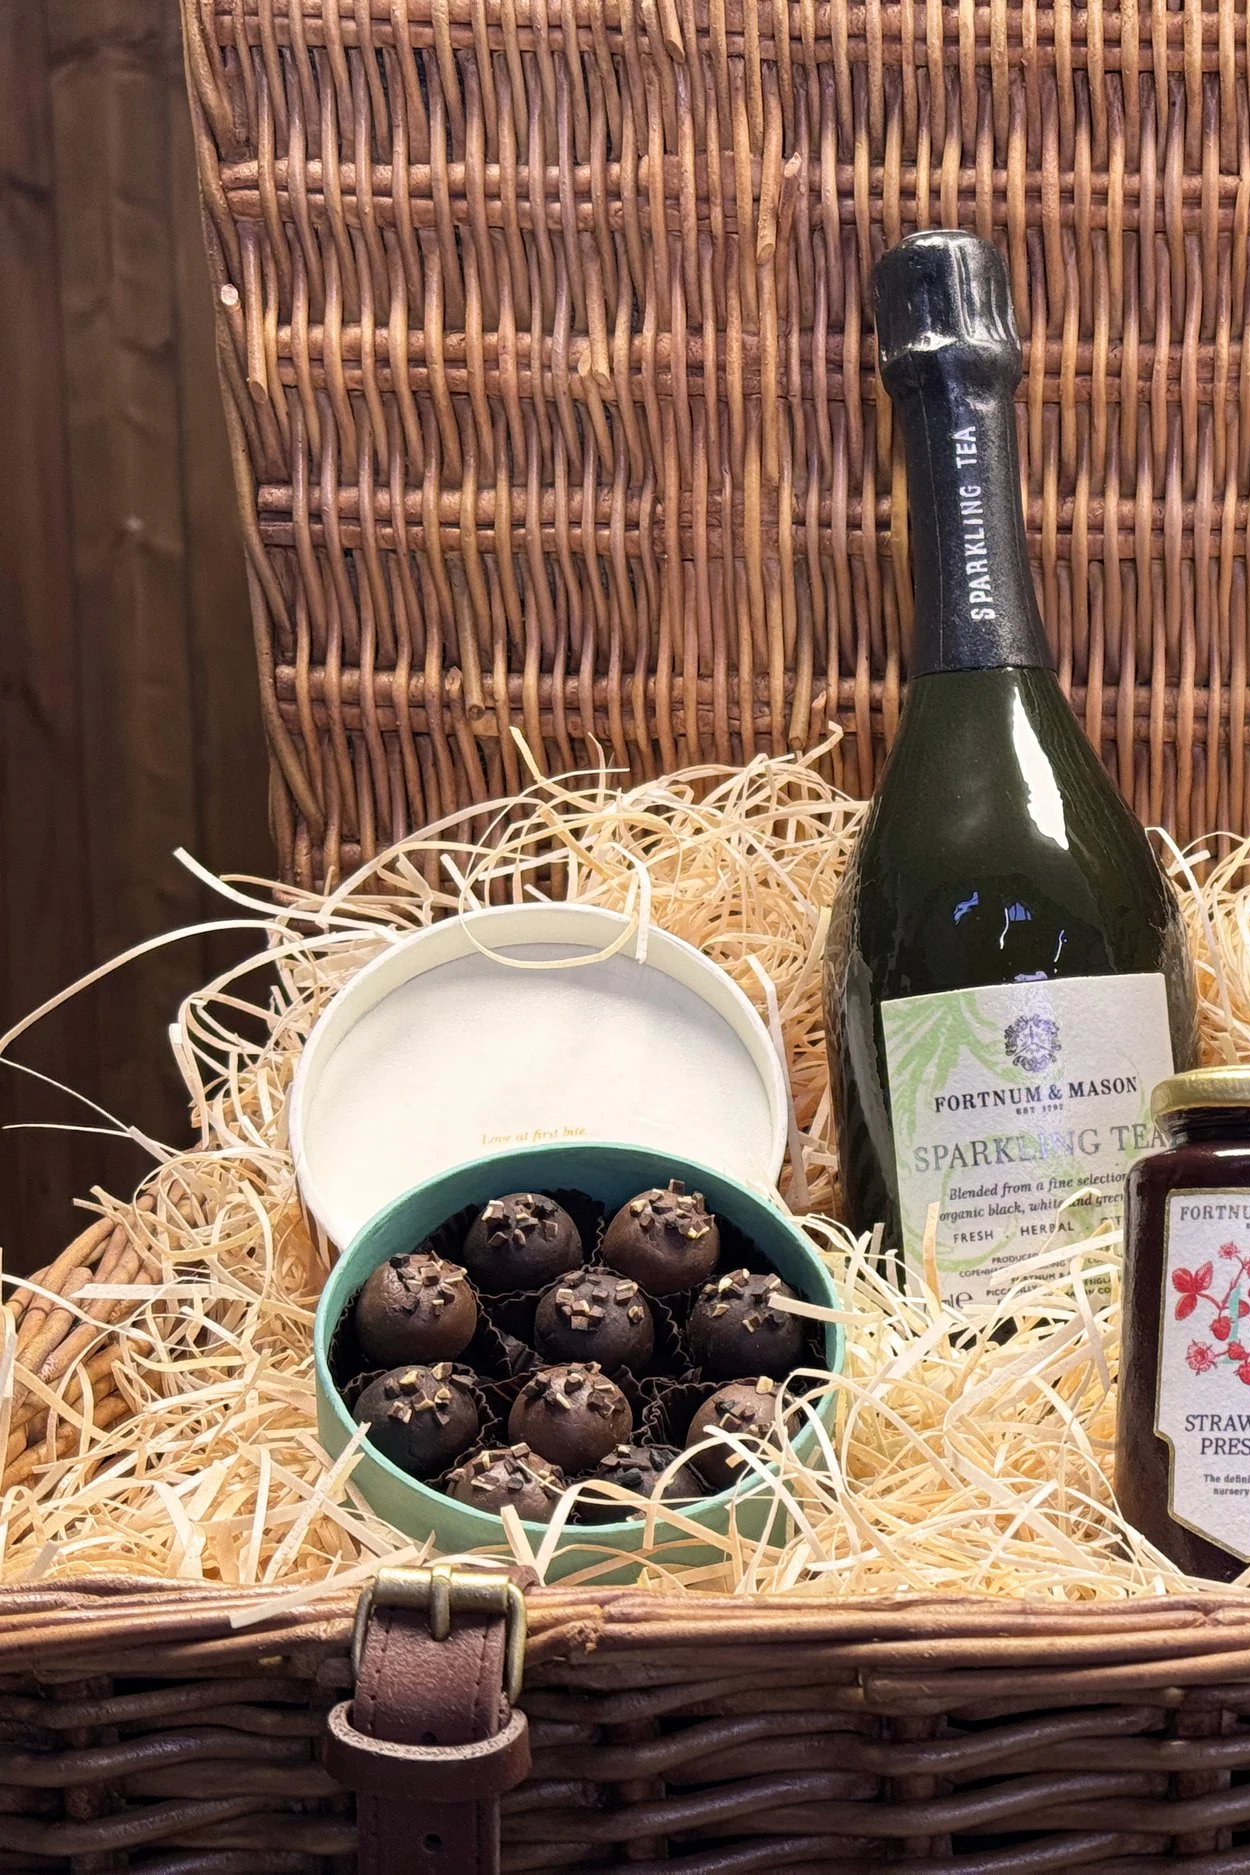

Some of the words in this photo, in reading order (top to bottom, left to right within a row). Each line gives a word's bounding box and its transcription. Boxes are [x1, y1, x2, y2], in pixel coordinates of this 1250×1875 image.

[952, 425, 976, 470] TEA
[959, 484, 996, 621] SPARKLING
[934, 1085, 1042, 1114] FORTNUM
[1048, 1084, 1063, 1100] &
[1068, 1076, 1139, 1099] MASON
[533, 1128, 559, 1142] first
[914, 1128, 1101, 1172] SPARKLING
[950, 1183, 998, 1200] Blended
[1001, 1181, 1032, 1197] from
[1036, 1182, 1045, 1191] a
[1047, 1176, 1073, 1192] fine
[940, 1208, 985, 1222] organic
[989, 1202, 1025, 1217] black,
[953, 1230, 994, 1244] FRESH
[1020, 1221, 1074, 1236] HERBAL
[1203, 1473, 1221, 1484] The
[1213, 1487, 1250, 1498] nursery
